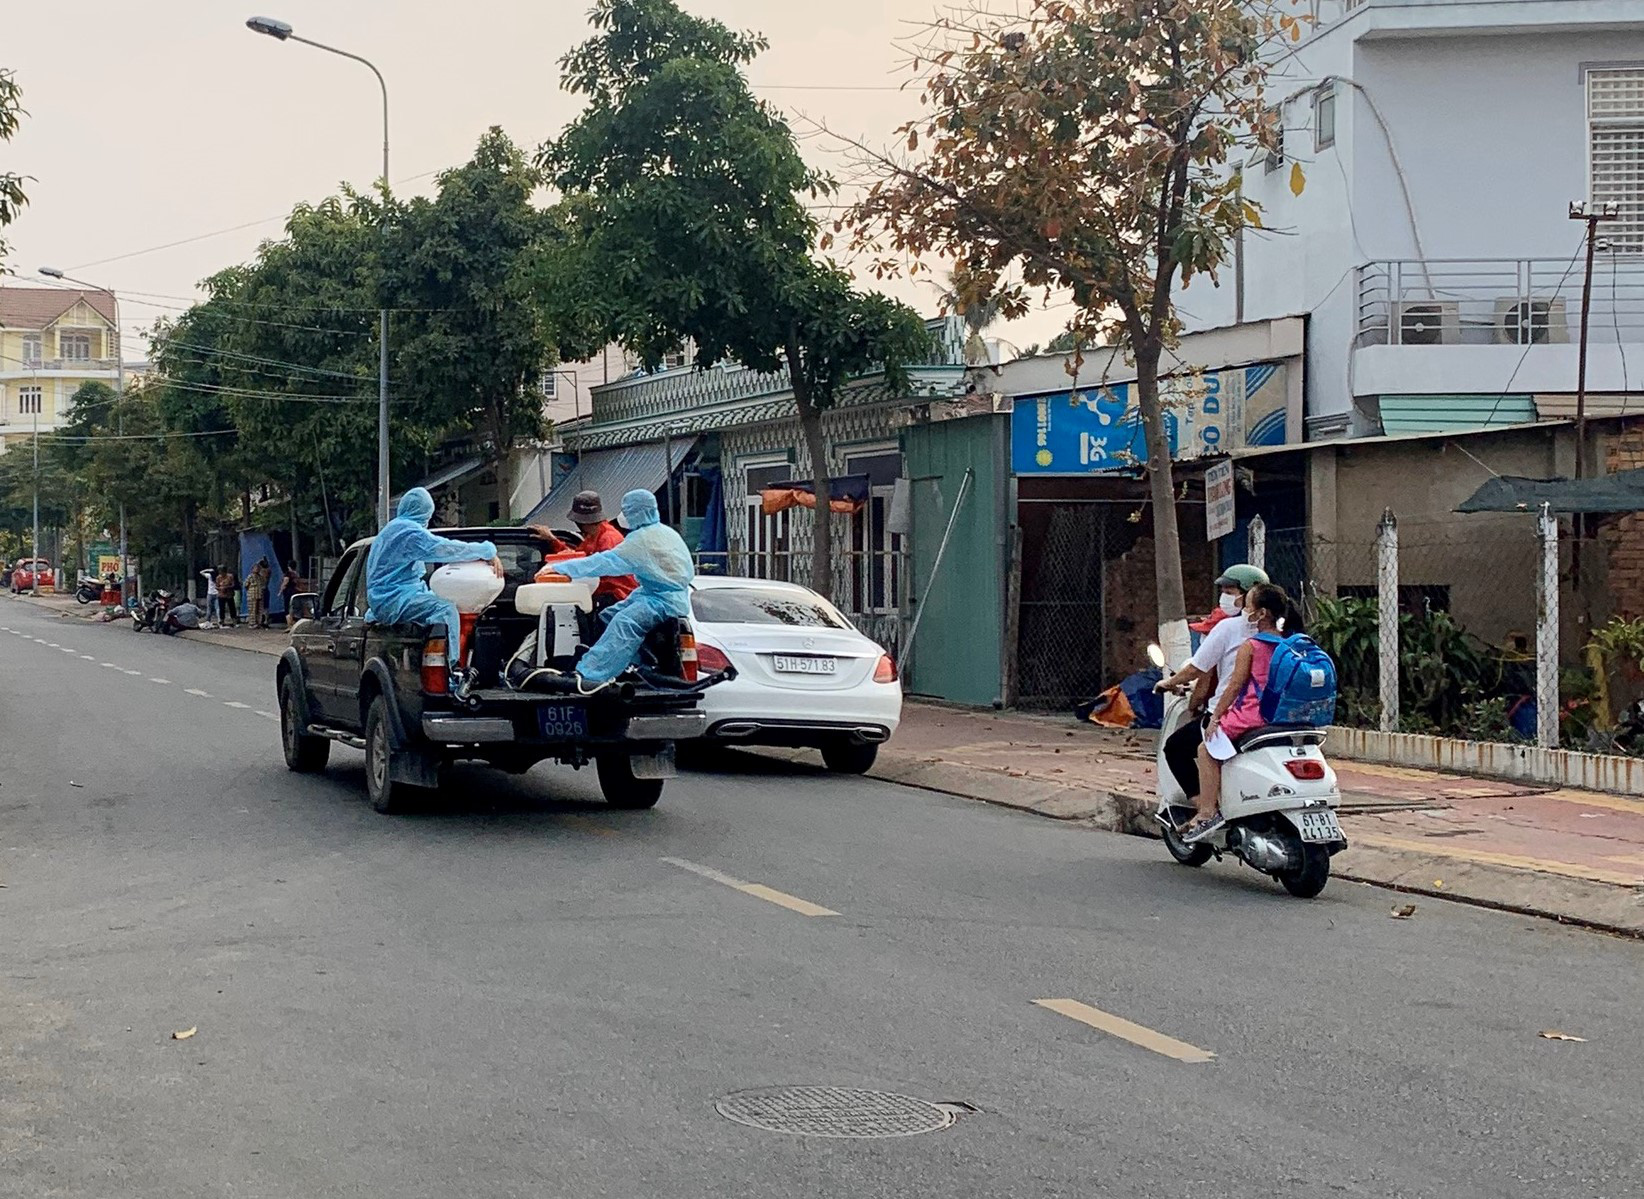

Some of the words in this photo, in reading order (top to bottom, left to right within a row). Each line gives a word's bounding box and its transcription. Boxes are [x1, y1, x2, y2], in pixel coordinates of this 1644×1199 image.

[1089, 435, 1108, 461] 3G
[776, 658, 836, 673] 51H-571.83
[547, 705, 576, 721] 61F
